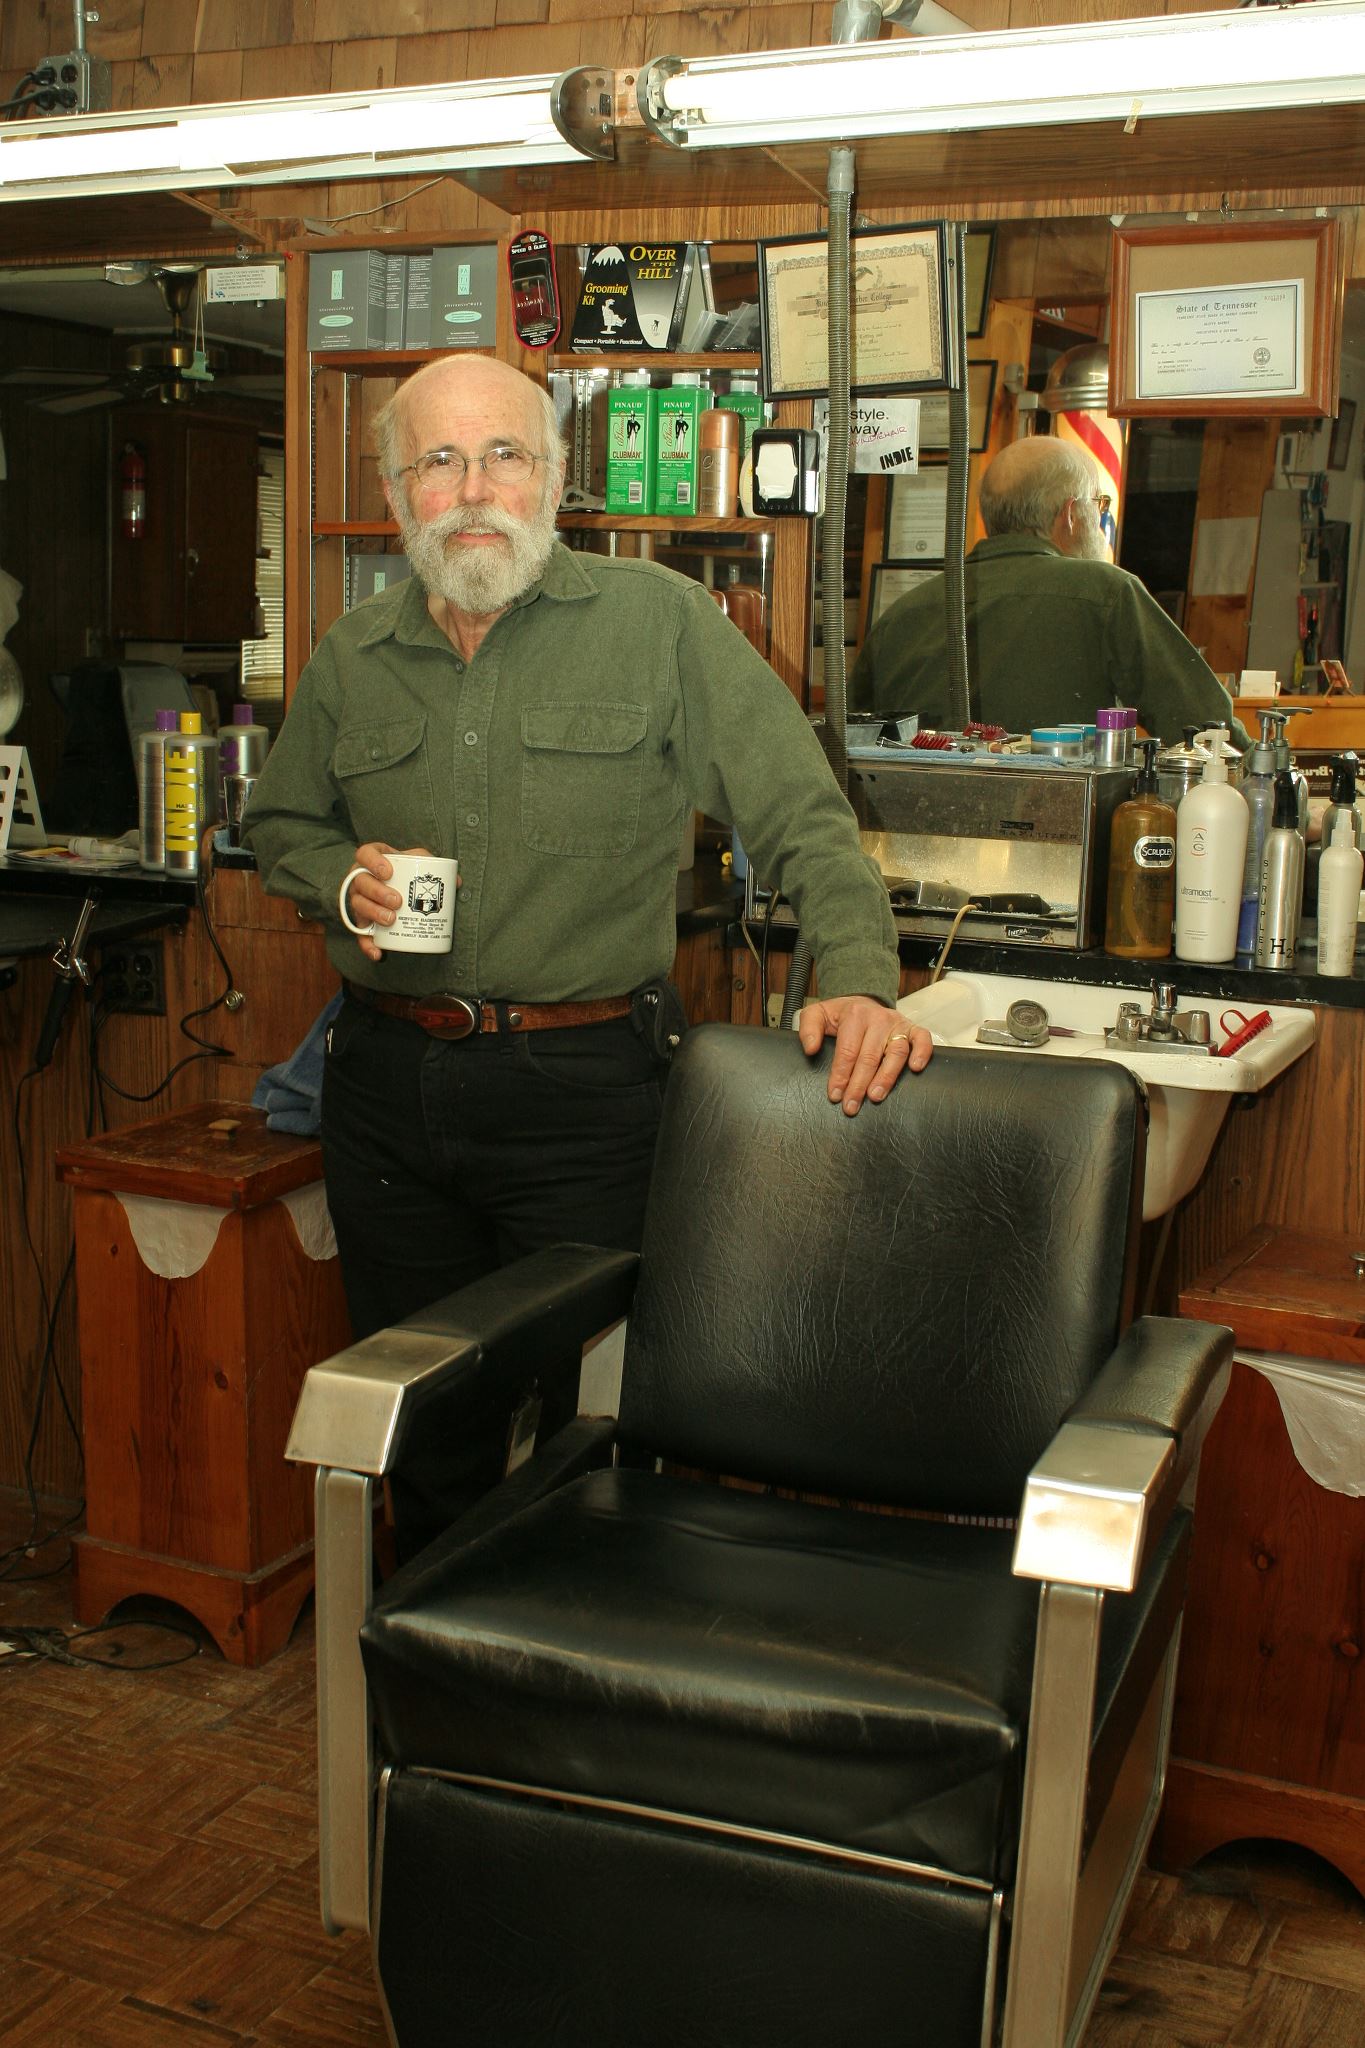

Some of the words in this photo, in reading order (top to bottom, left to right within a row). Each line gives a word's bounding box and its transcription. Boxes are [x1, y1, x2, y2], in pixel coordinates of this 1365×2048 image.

[629, 245, 677, 261] OVER
[636, 267, 673, 280] HILL
[585, 282, 629, 296] Grooming
[581, 295, 596, 306] Kit
[1175, 305, 1199, 314] State
[1201, 303, 1209, 312] of
[1213, 301, 1258, 311] Tennessee
[614, 401, 641, 409] PINAUD
[663, 401, 690, 409] PINAUD
[850, 408, 889, 422] style.
[612, 451, 641, 459] CLUBMAN
[661, 451, 690, 459] CLUBMAN
[879, 446, 914, 470] INDIE
[165, 751, 198, 852] INDIE
[1193, 832, 1204, 841] A
[1141, 846, 1173, 858] SCRUPLES
[1193, 843, 1205, 852] G
[1180, 886, 1213, 897] ultramoist
[1257, 859, 1269, 957] SCRUPLES
